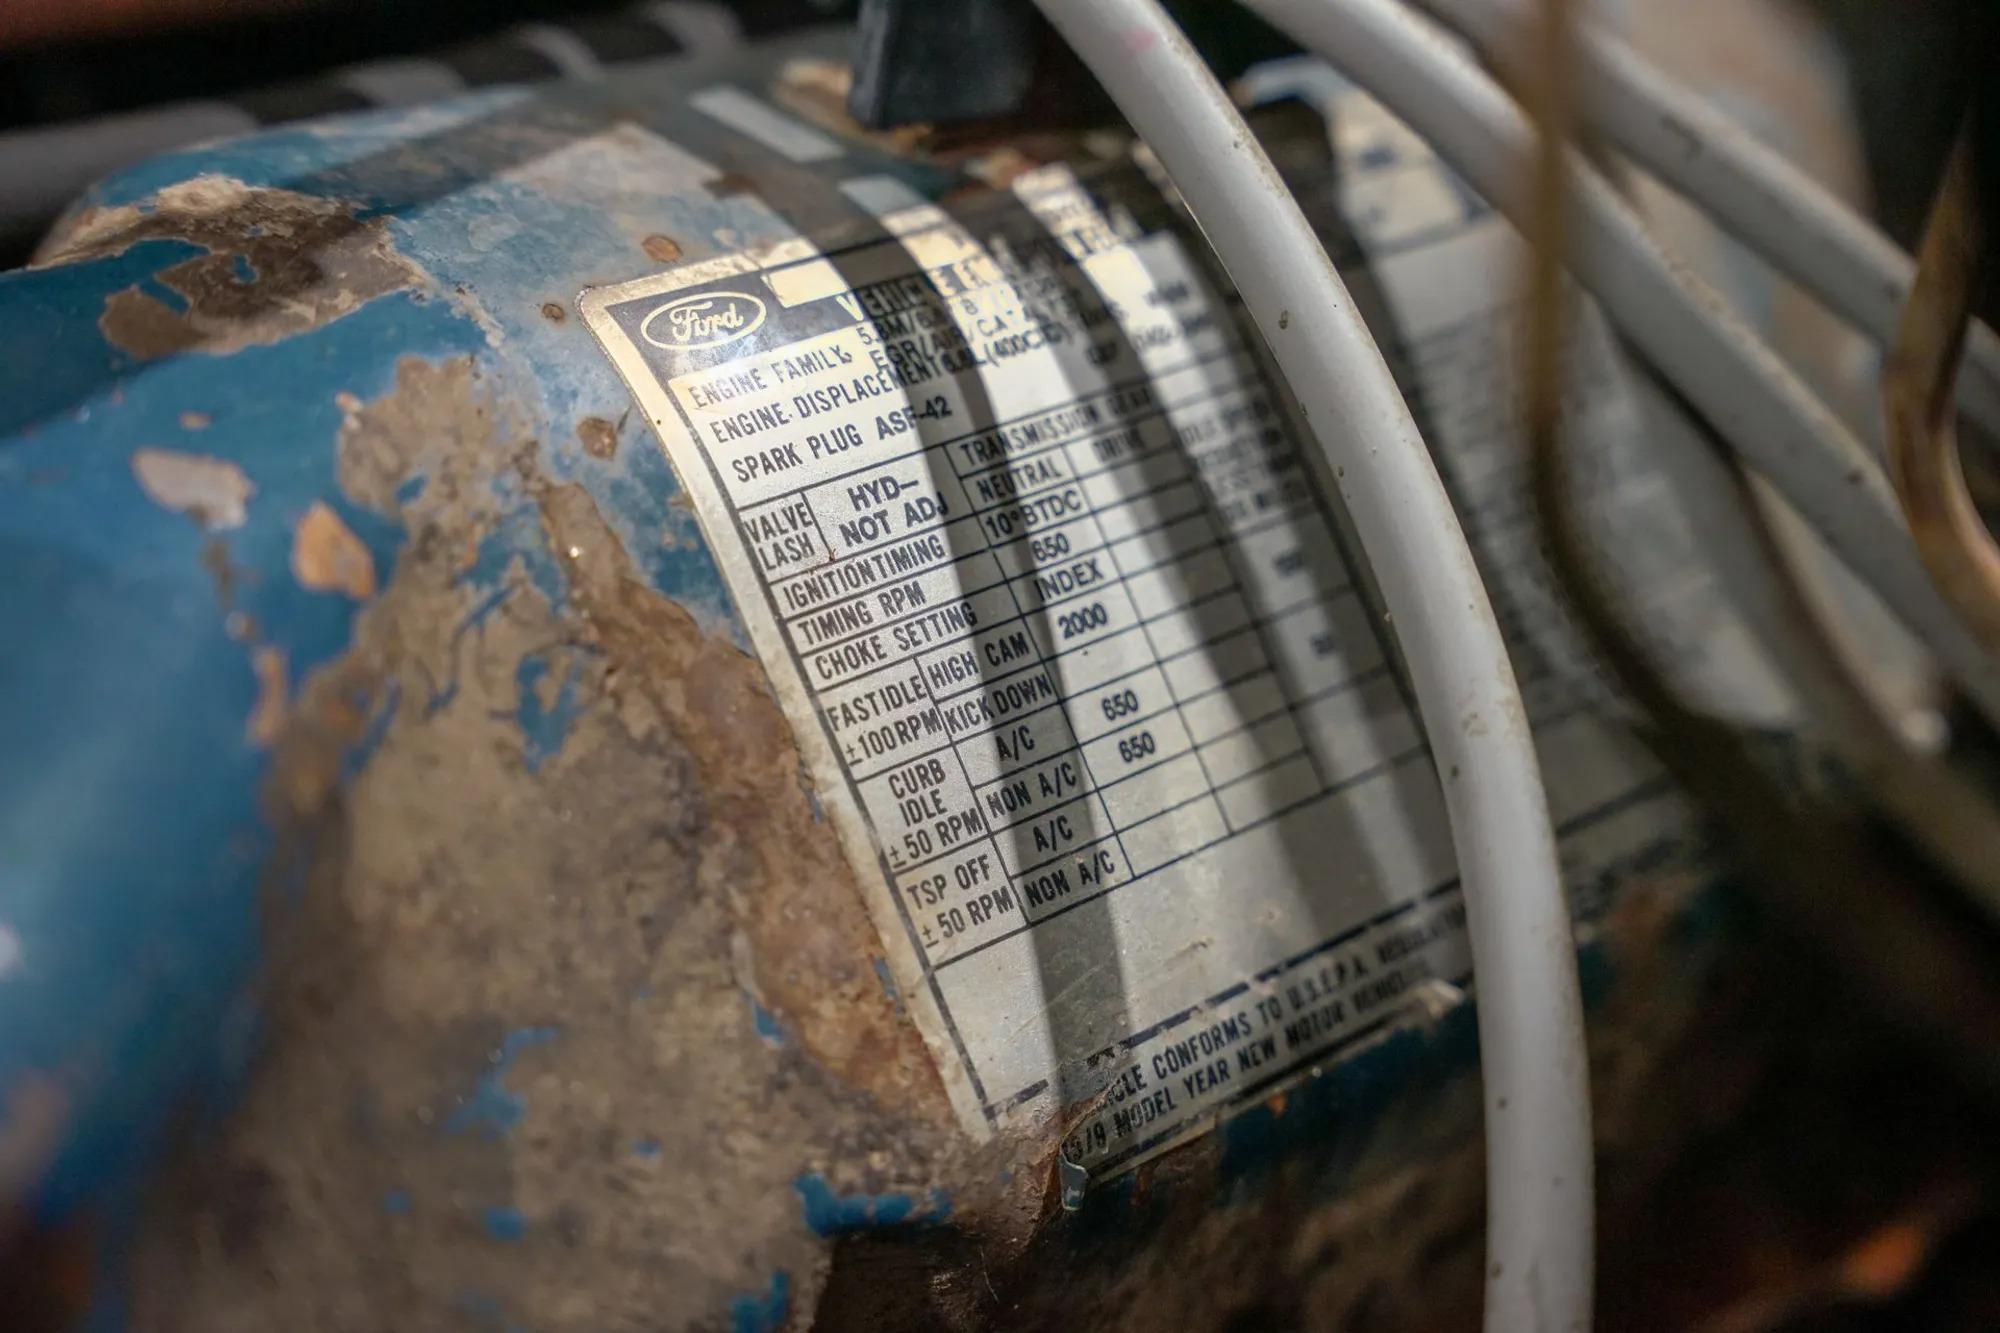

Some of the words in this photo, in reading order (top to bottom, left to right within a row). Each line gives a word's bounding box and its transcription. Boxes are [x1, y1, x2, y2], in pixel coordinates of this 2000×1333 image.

[669, 301, 745, 342] Ford
[836, 268, 958, 321] VEHICE
[688, 377, 768, 410] ENGINE
[710, 404, 788, 444] ENGINE
[799, 352, 942, 418] DISPLACEMENT
[732, 445, 803, 483] SPARK
[806, 424, 863, 458] PLUG
[876, 397, 952, 441] ASF-42
[976, 458, 1062, 502] NEUTRAL
[744, 502, 813, 543] VALVE
[839, 510, 892, 547] NOT
[904, 492, 948, 528] ADJ
[759, 532, 815, 570] LASH
[797, 601, 873, 645] TIMING
[877, 580, 927, 617] RPM
[815, 632, 887, 680] CHOKE
[893, 602, 978, 651] SETTING
[1034, 559, 1104, 601] INDEX
[927, 651, 980, 689] HIGH
[984, 632, 1030, 667] CAM
[1058, 603, 1108, 639] 2000
[995, 725, 1035, 761] A/C
[1102, 690, 1139, 721] 650
[888, 758, 946, 799] CURB
[986, 781, 1032, 818] NON
[1038, 763, 1077, 797] A/C
[1118, 731, 1156, 763] 650
[900, 788, 947, 827] IDLE
[935, 808, 983, 847] RPM
[1033, 815, 1073, 852] A/C
[906, 873, 947, 910] TSP
[954, 853, 990, 891] OFF
[966, 886, 1014, 926] RPM
[1024, 870, 1071, 908] NON
[1078, 850, 1115, 885] A/C
[1152, 1012, 1251, 1080] CONFORMS
[1256, 996, 1283, 1025] TO
[1113, 1087, 1177, 1139] MODEL
[1183, 1059, 1231, 1099] YEAR
[1238, 1033, 1276, 1073] NEW
[1285, 1000, 1345, 1046] MOTOR
